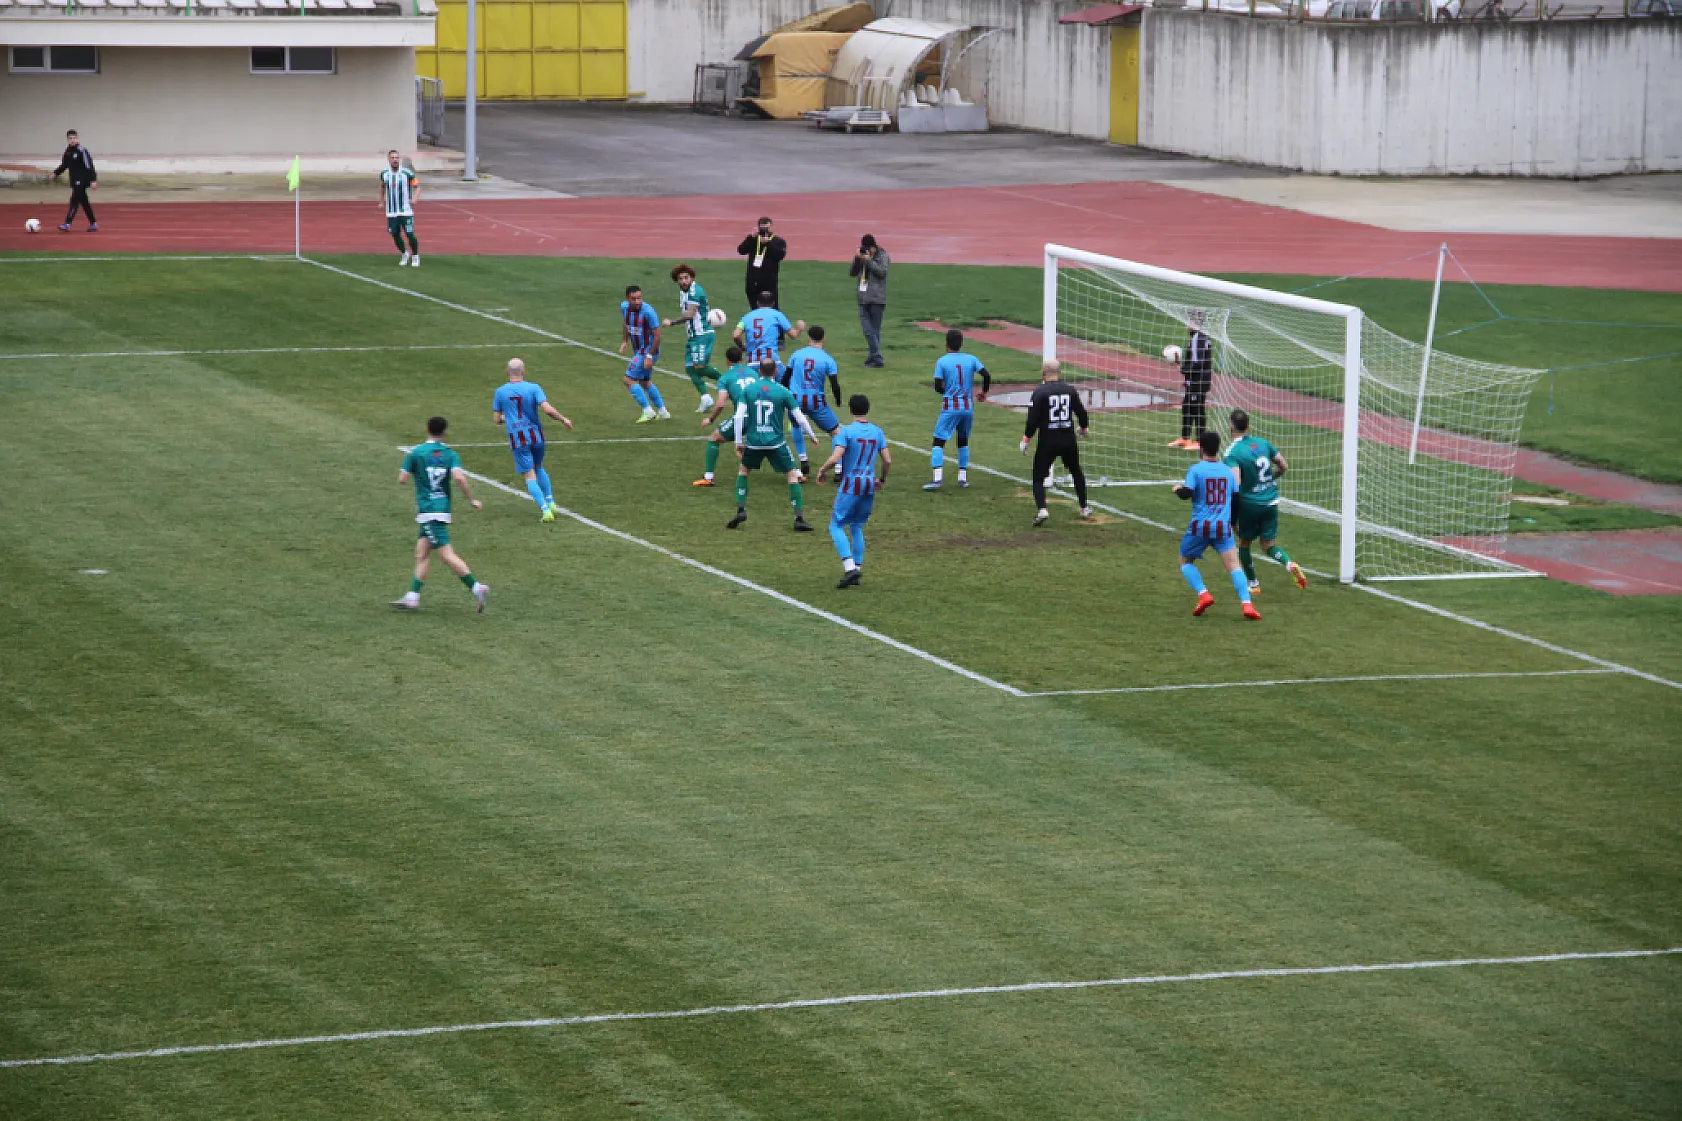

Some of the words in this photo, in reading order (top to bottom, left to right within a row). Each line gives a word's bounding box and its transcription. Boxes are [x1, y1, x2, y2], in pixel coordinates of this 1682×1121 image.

[753, 318, 763, 339] 5
[804, 358, 815, 382] 2
[956, 364, 964, 387] 1
[509, 395, 523, 419] 7
[754, 400, 773, 425] 17
[1048, 394, 1070, 421] 23
[856, 438, 877, 466] 77
[1255, 456, 1273, 482] 2
[1205, 477, 1227, 505] 88
